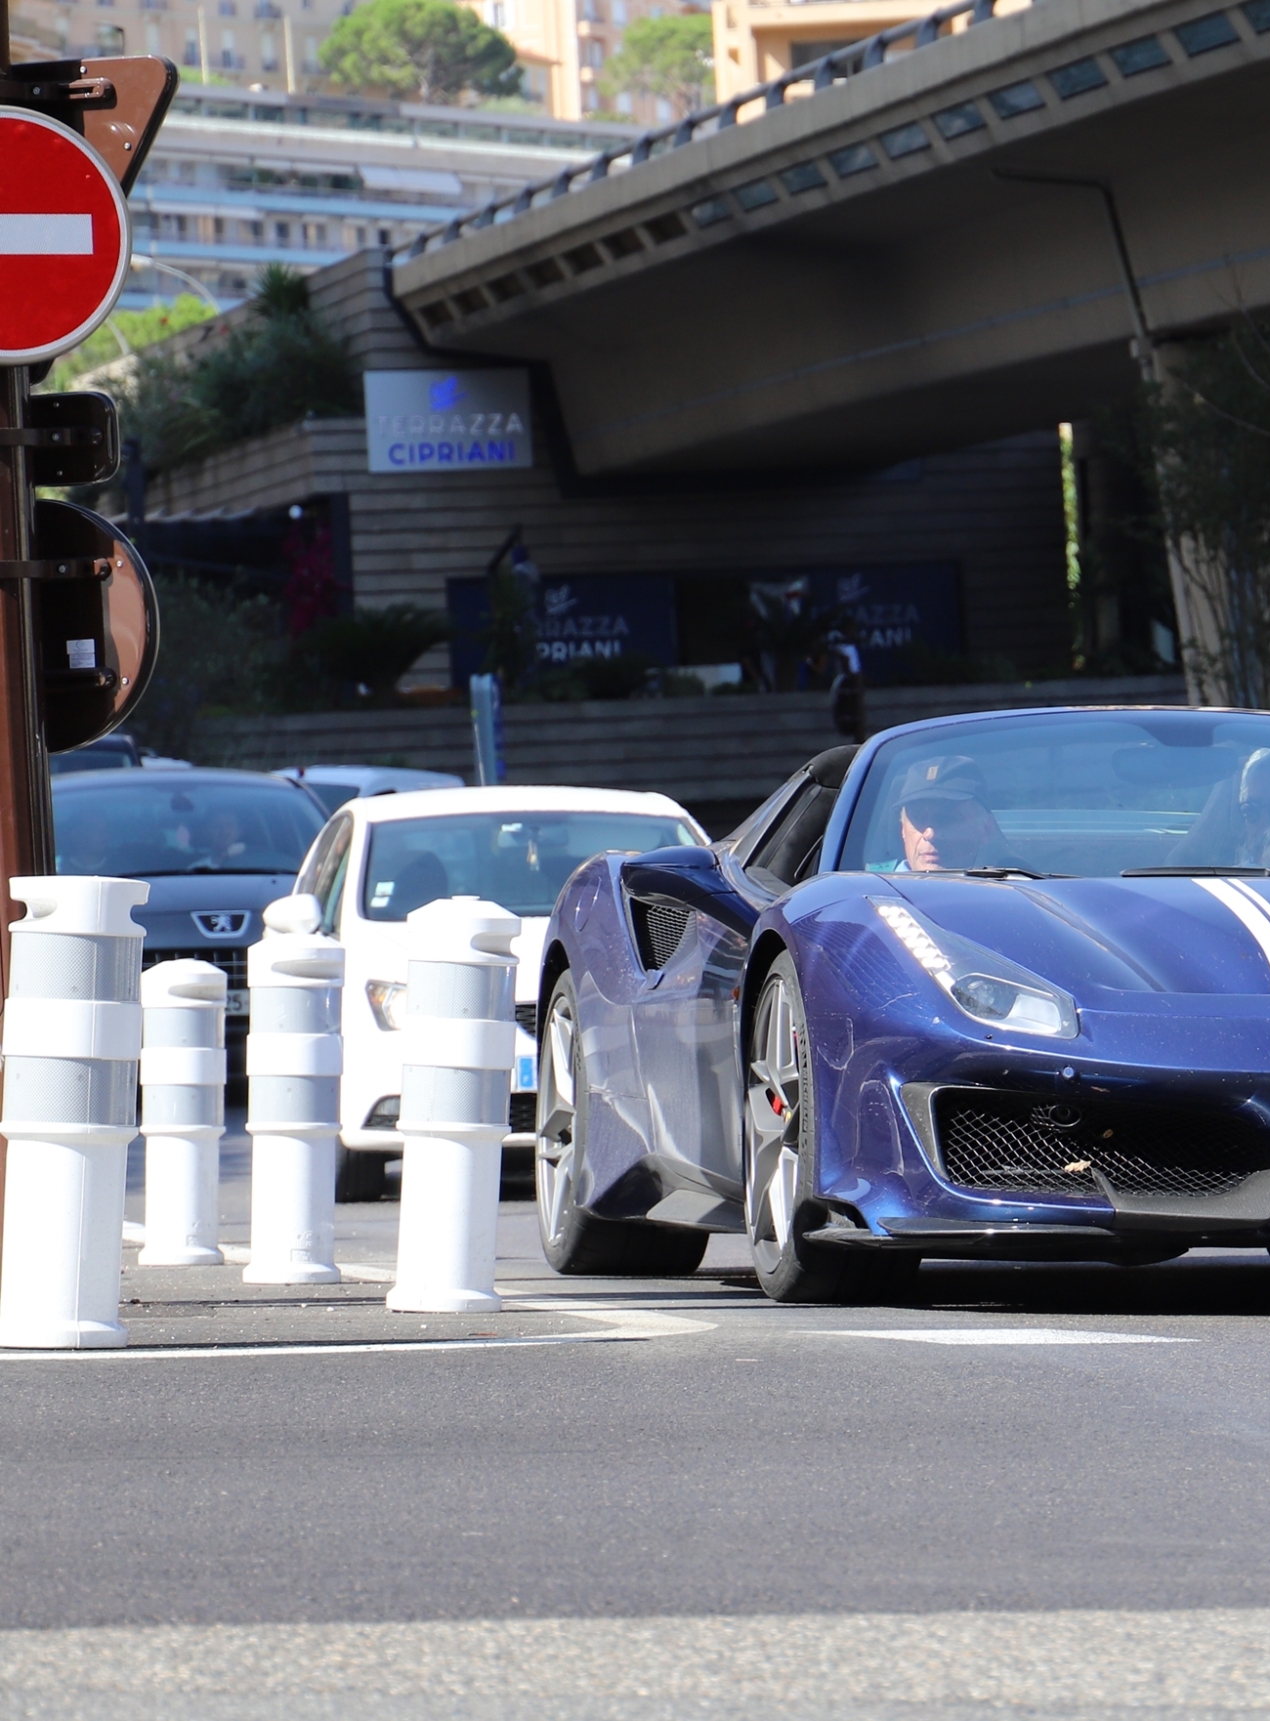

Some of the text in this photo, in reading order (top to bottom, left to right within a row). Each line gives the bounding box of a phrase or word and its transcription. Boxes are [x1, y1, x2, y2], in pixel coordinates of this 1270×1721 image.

[377, 412, 525, 438] TERRAZZA
[388, 440, 516, 466] CIPRIANI
[535, 638, 622, 662] PRIANI
